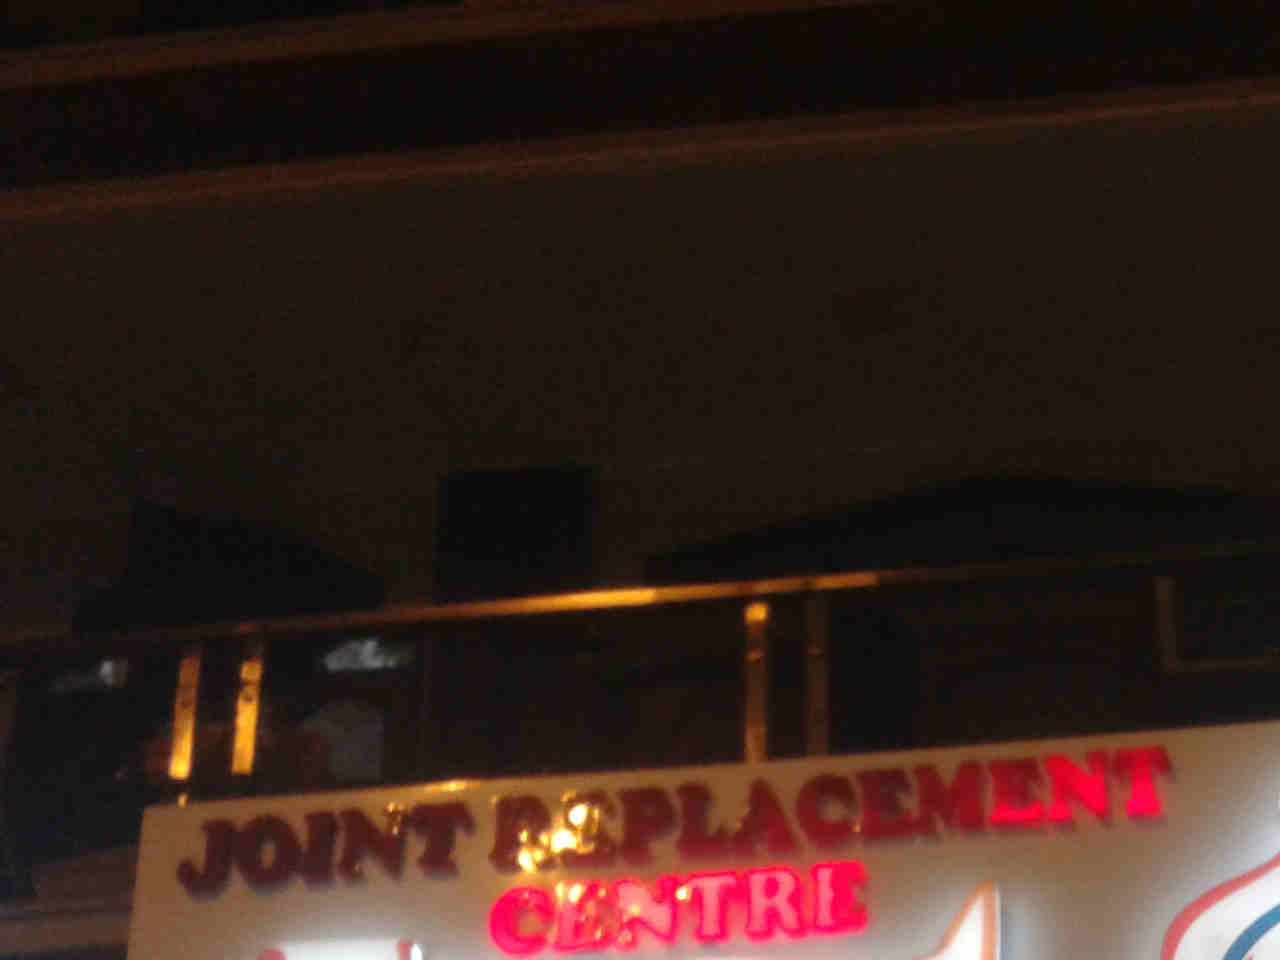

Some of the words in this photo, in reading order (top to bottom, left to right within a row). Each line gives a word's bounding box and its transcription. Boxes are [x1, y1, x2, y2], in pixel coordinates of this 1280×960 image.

[178, 802, 473, 900] JOINT
[490, 744, 1171, 875] REPLACEMENT
[489, 860, 868, 959] CENTRE
